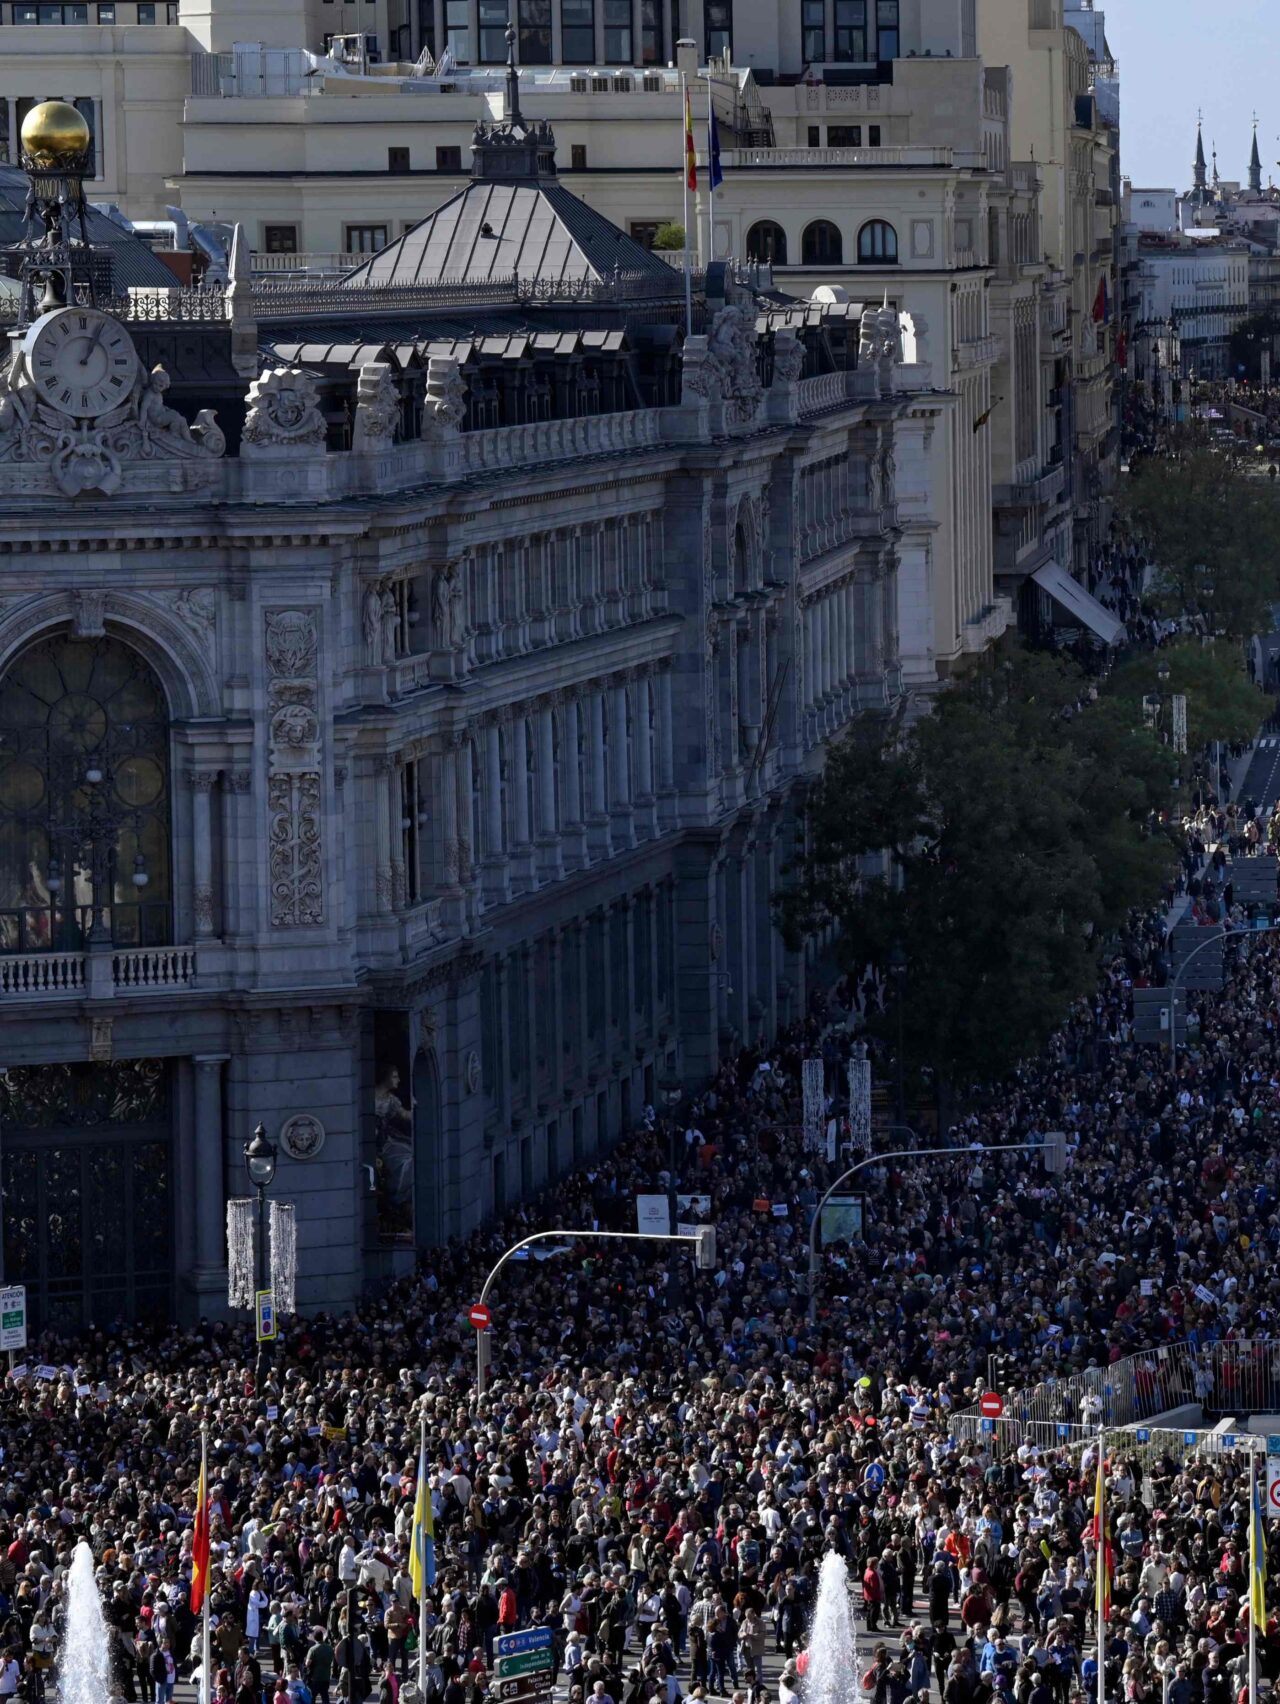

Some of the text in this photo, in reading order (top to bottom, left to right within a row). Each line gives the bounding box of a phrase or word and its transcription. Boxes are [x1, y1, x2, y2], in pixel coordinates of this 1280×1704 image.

[2, 1291, 24, 1300] ATENCIÓN
[528, 1633, 550, 1643] Valencia
[520, 1658, 550, 1669] Independencia
